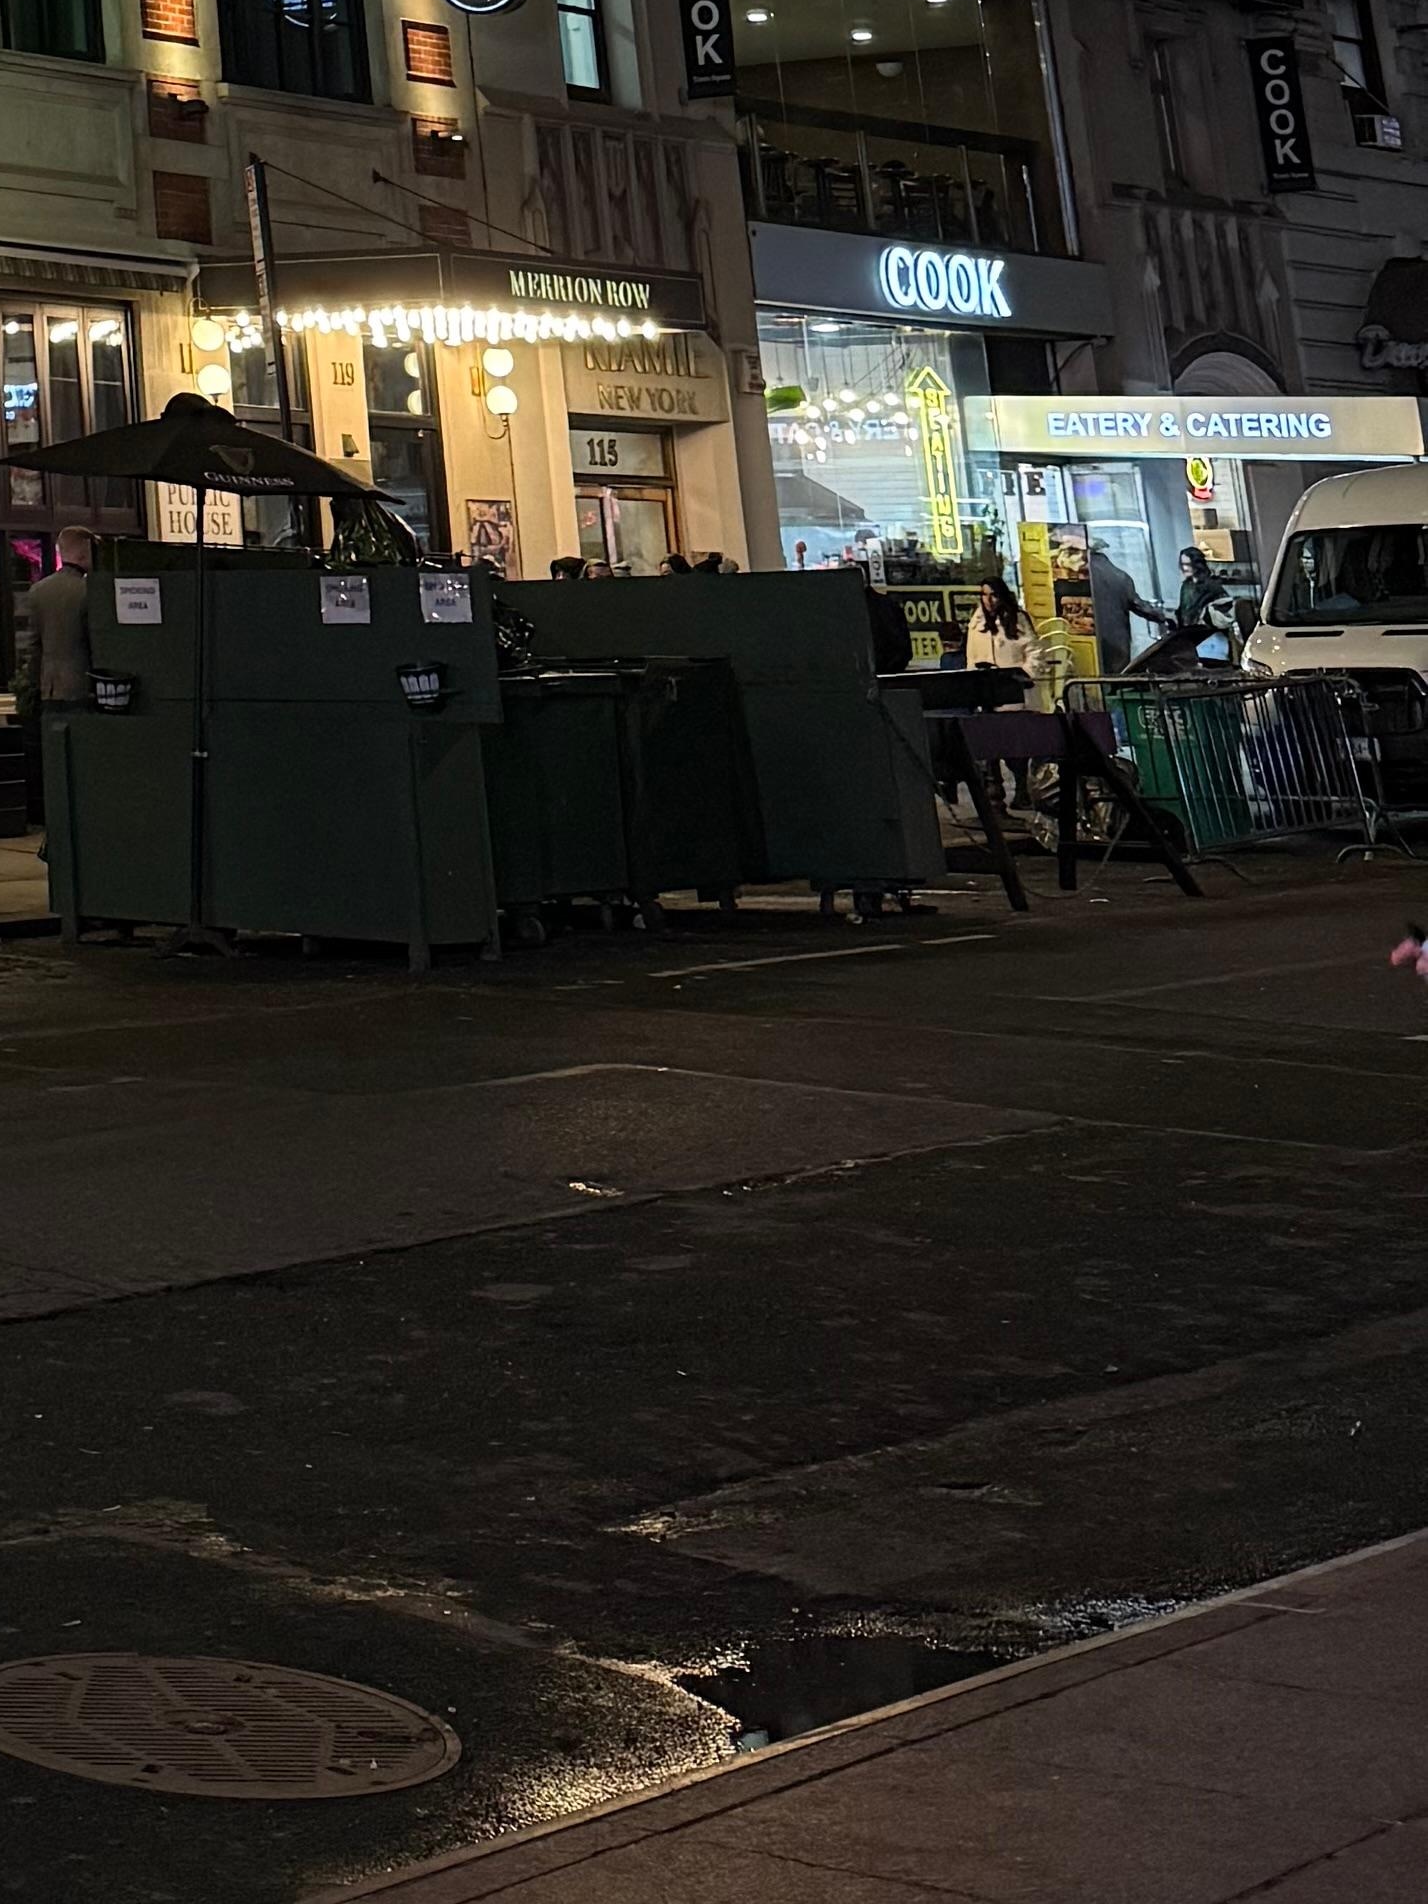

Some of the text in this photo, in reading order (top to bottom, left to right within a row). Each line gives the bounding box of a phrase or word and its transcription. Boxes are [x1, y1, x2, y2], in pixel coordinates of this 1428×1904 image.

[1260, 49, 1302, 165] COOK
[509, 270, 650, 309] MERRION ROW
[879, 246, 1011, 318] COOK
[331, 362, 355, 386] 119
[597, 383, 699, 415] NEW YORK
[1047, 411, 1332, 439] EATERY & CATERING
[587, 438, 618, 467] 115
[924, 388, 956, 539] SEATING
[203, 471, 294, 487] GUINNESS
[168, 485, 231, 508] PULIC
[904, 599, 941, 623] OOK
